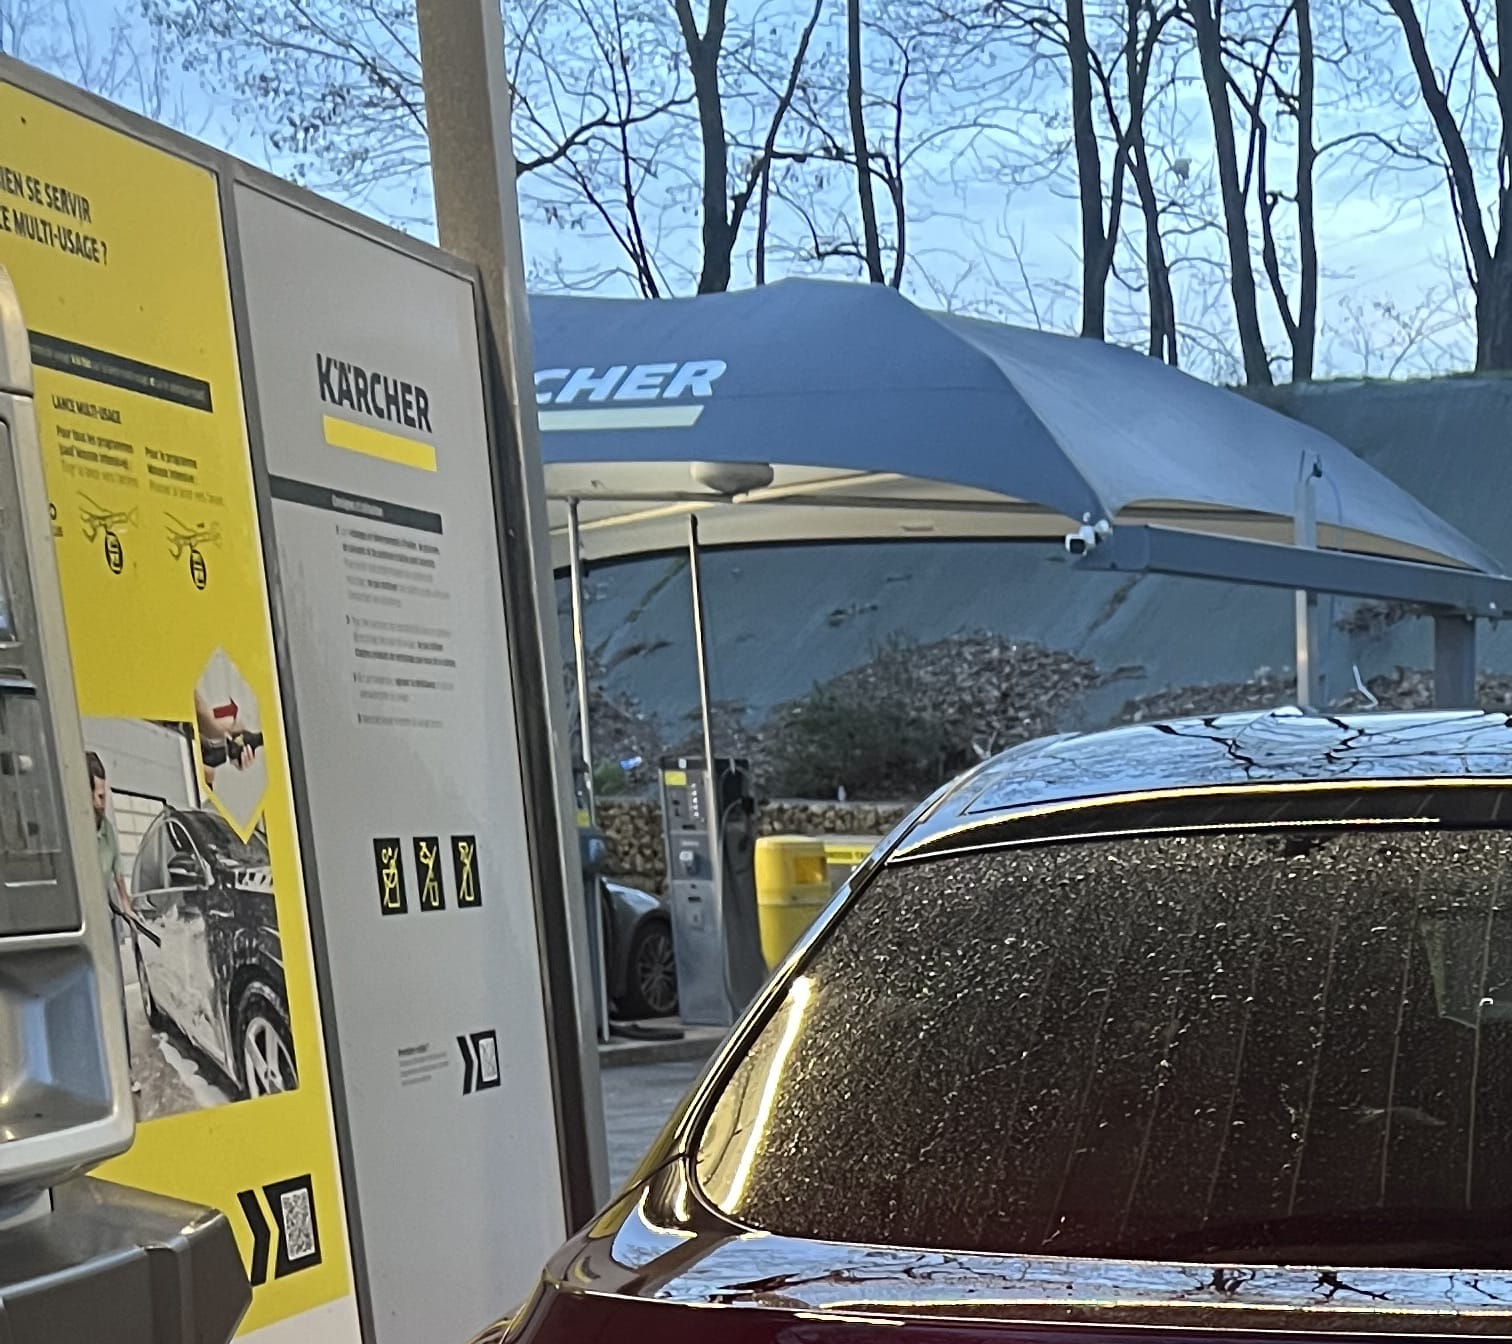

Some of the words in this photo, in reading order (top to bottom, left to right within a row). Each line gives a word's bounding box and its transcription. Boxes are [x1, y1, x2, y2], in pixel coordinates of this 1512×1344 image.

[0, 165, 24, 198] IEN
[25, 175, 44, 206] SE
[44, 182, 92, 224] SERVIR
[12, 208, 100, 264] MULTI-USAGE
[316, 352, 433, 434] KÄRCHER
[534, 359, 727, 404] CHER
